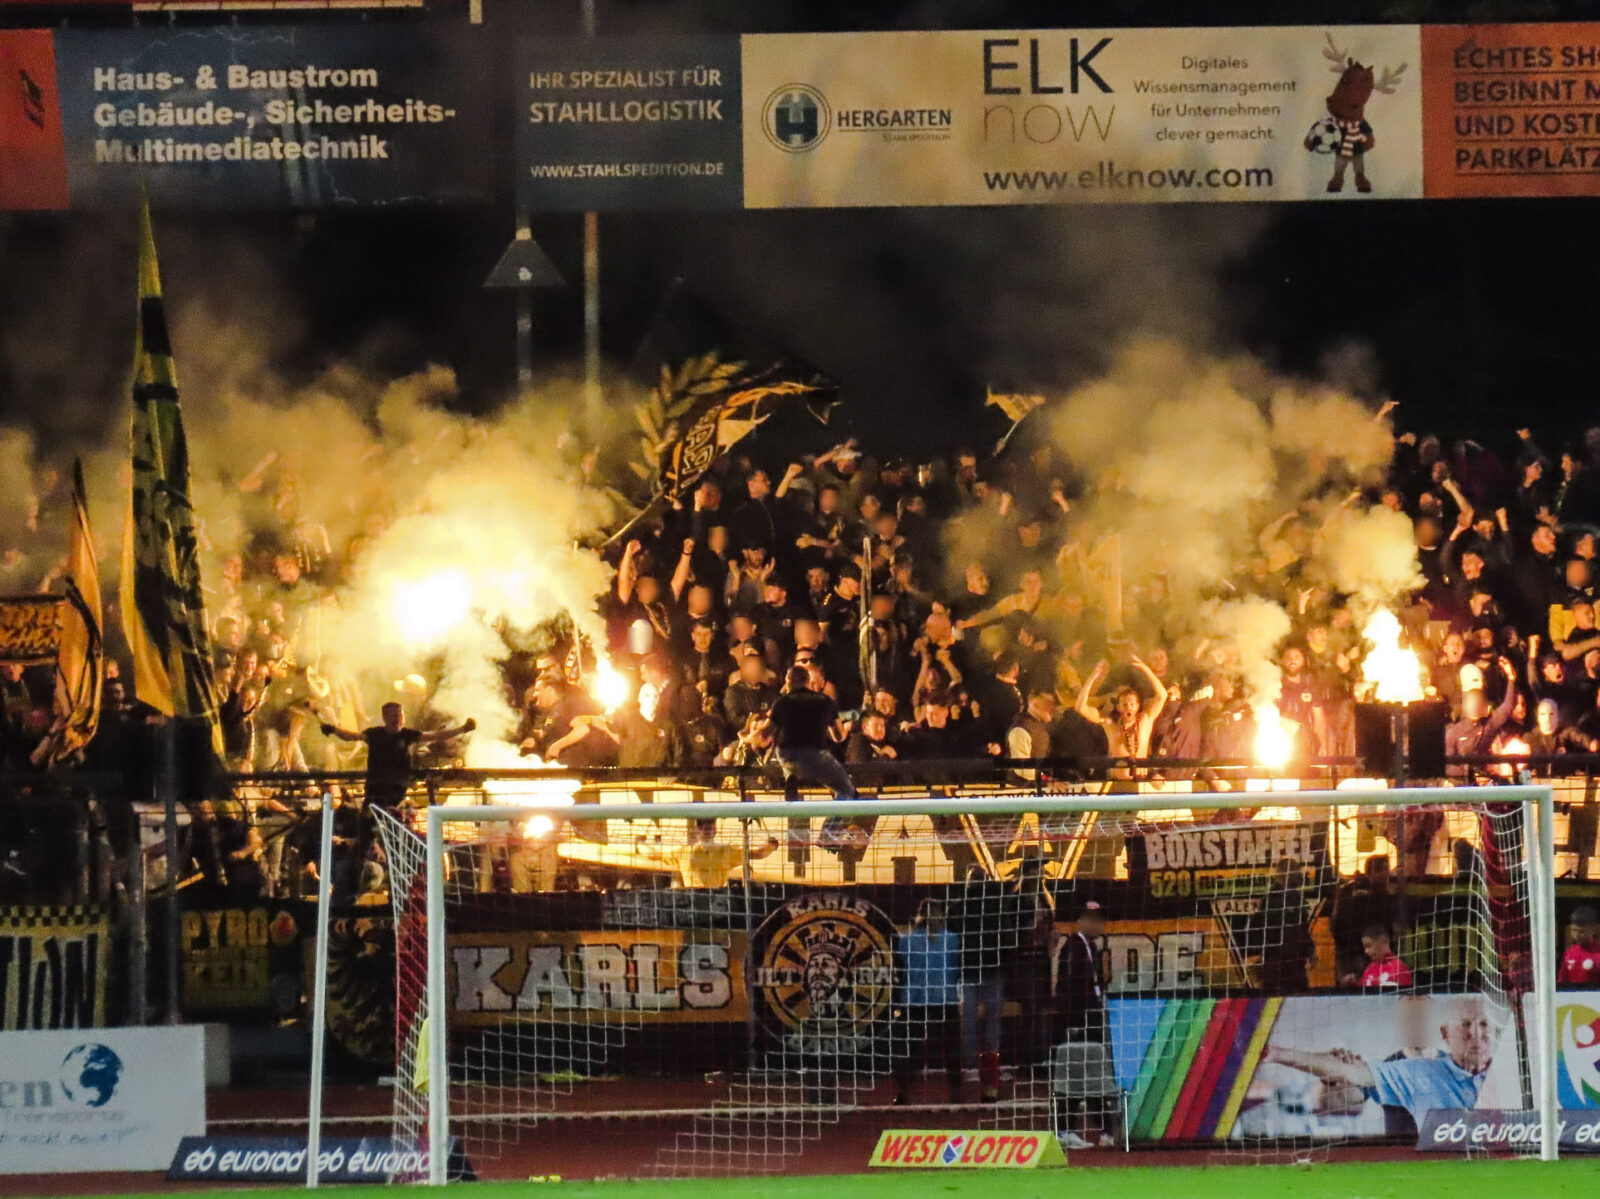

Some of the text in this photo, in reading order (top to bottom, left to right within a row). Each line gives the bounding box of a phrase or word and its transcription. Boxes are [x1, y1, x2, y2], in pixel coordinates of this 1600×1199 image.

[529, 65, 722, 89] IHR SPEZIALIST FÜR
[983, 37, 1115, 96] ELK
[1181, 55, 1249, 73] Digitales
[94, 64, 378, 91] Haus- & Baustrom
[1133, 78, 1297, 96] Wissensmanagement
[1454, 79, 1577, 103] BEGINNT
[94, 99, 456, 129] Gebäude-, Sicherheits-
[529, 98, 723, 123] STAHLLOGISTIK
[837, 108, 952, 127] HERGARTEN
[983, 103, 1117, 144] now
[1150, 102, 1281, 119] für Unternehmen
[1155, 125, 1202, 141] clever
[1455, 114, 1515, 136] UND
[95, 135, 389, 163] Multimediatechnik
[530, 162, 724, 178] WWW.STAHLSPEDITION.DE
[983, 161, 1273, 190] www.elknow.com
[1145, 828, 1314, 869] BOXSTAFFEL
[1150, 870, 1191, 898] 520
[452, 945, 731, 1011] KARLS
[880, 1135, 1038, 1164] WEST LOTTO
